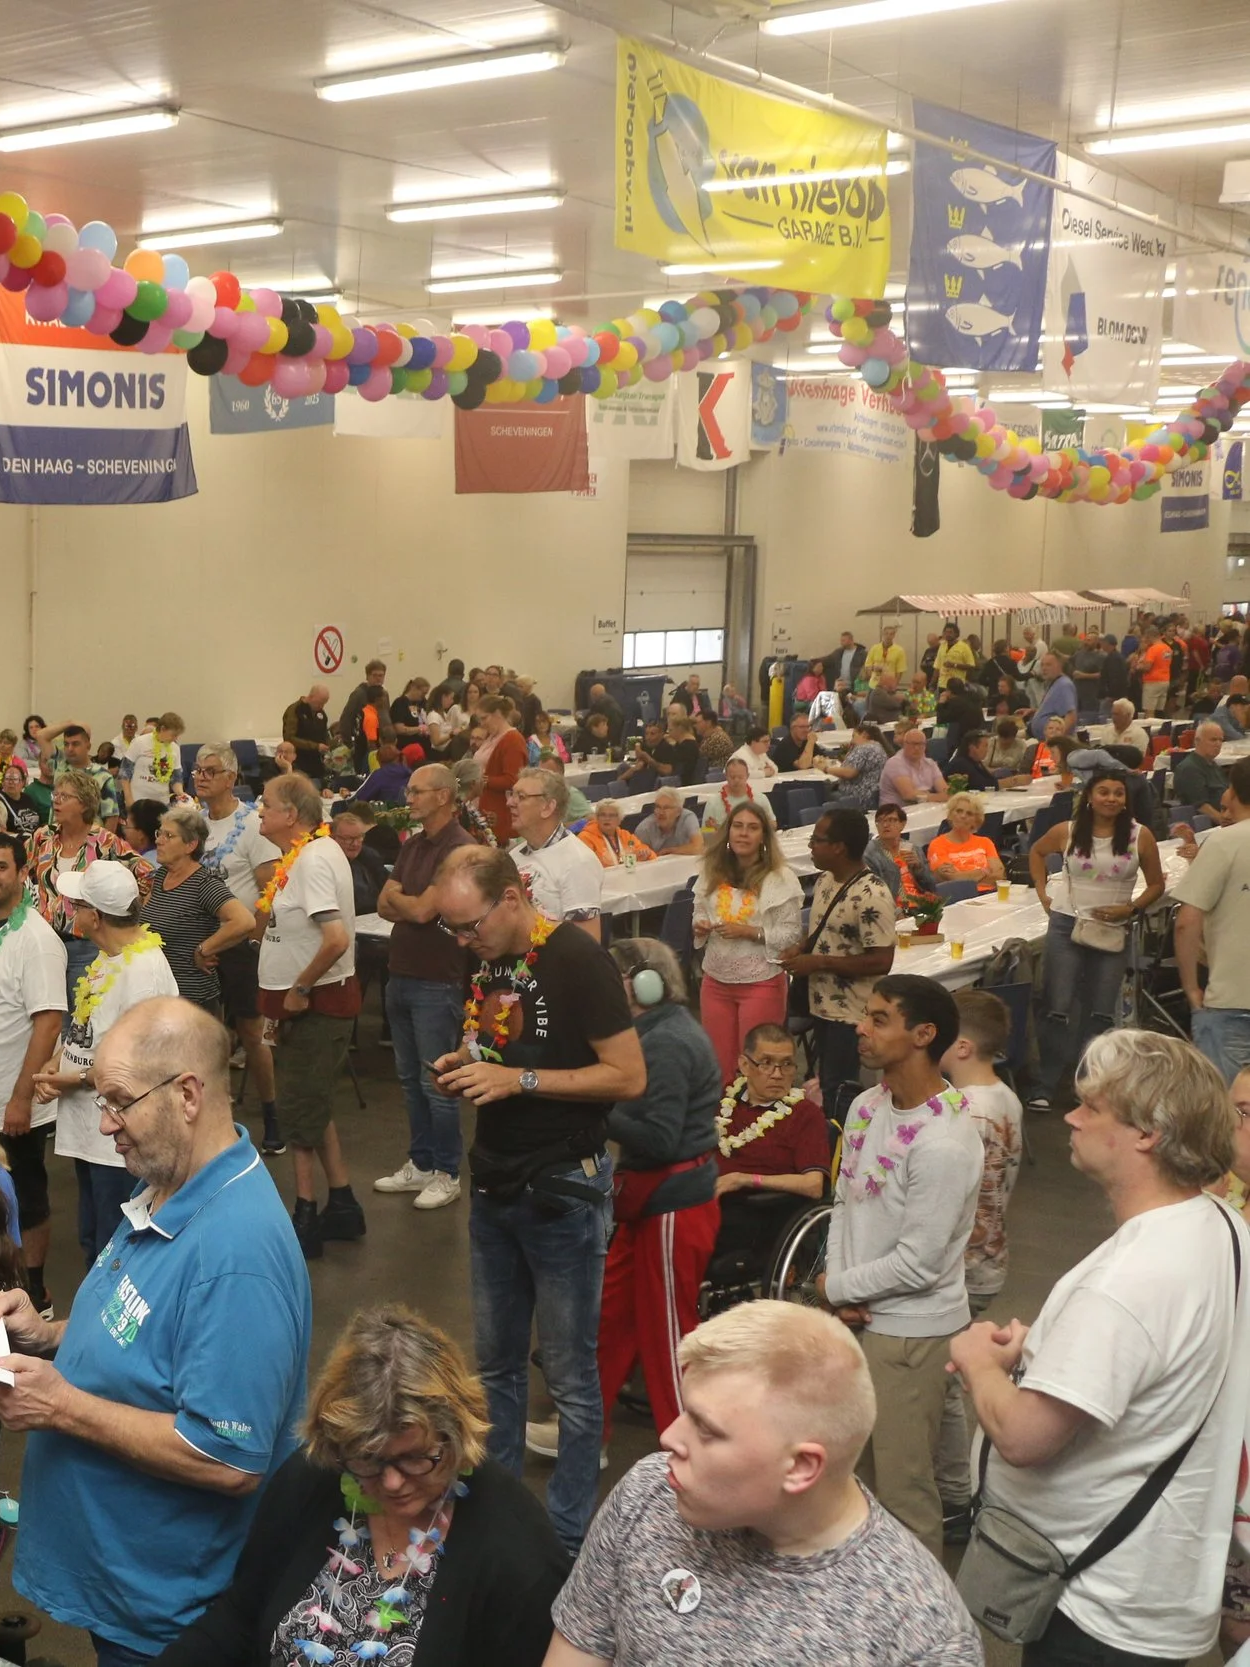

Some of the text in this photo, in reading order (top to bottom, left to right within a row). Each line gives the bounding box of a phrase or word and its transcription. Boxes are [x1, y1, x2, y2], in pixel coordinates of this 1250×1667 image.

[777, 216, 835, 247] GARAGE
[1061, 207, 1093, 239] Diesel
[25, 366, 166, 410] SIMONIS
[231, 400, 250, 412] 1960
[490, 426, 554, 437] SCHEVENINGEN
[2, 457, 31, 473] DEN
[34, 458, 74, 474] HAAG
[1171, 470, 1203, 487] SIMONIS
[598, 619, 617, 629] Buffet
[535, 995, 549, 1038] VIBE
[231, 1420, 253, 1433] Wales
